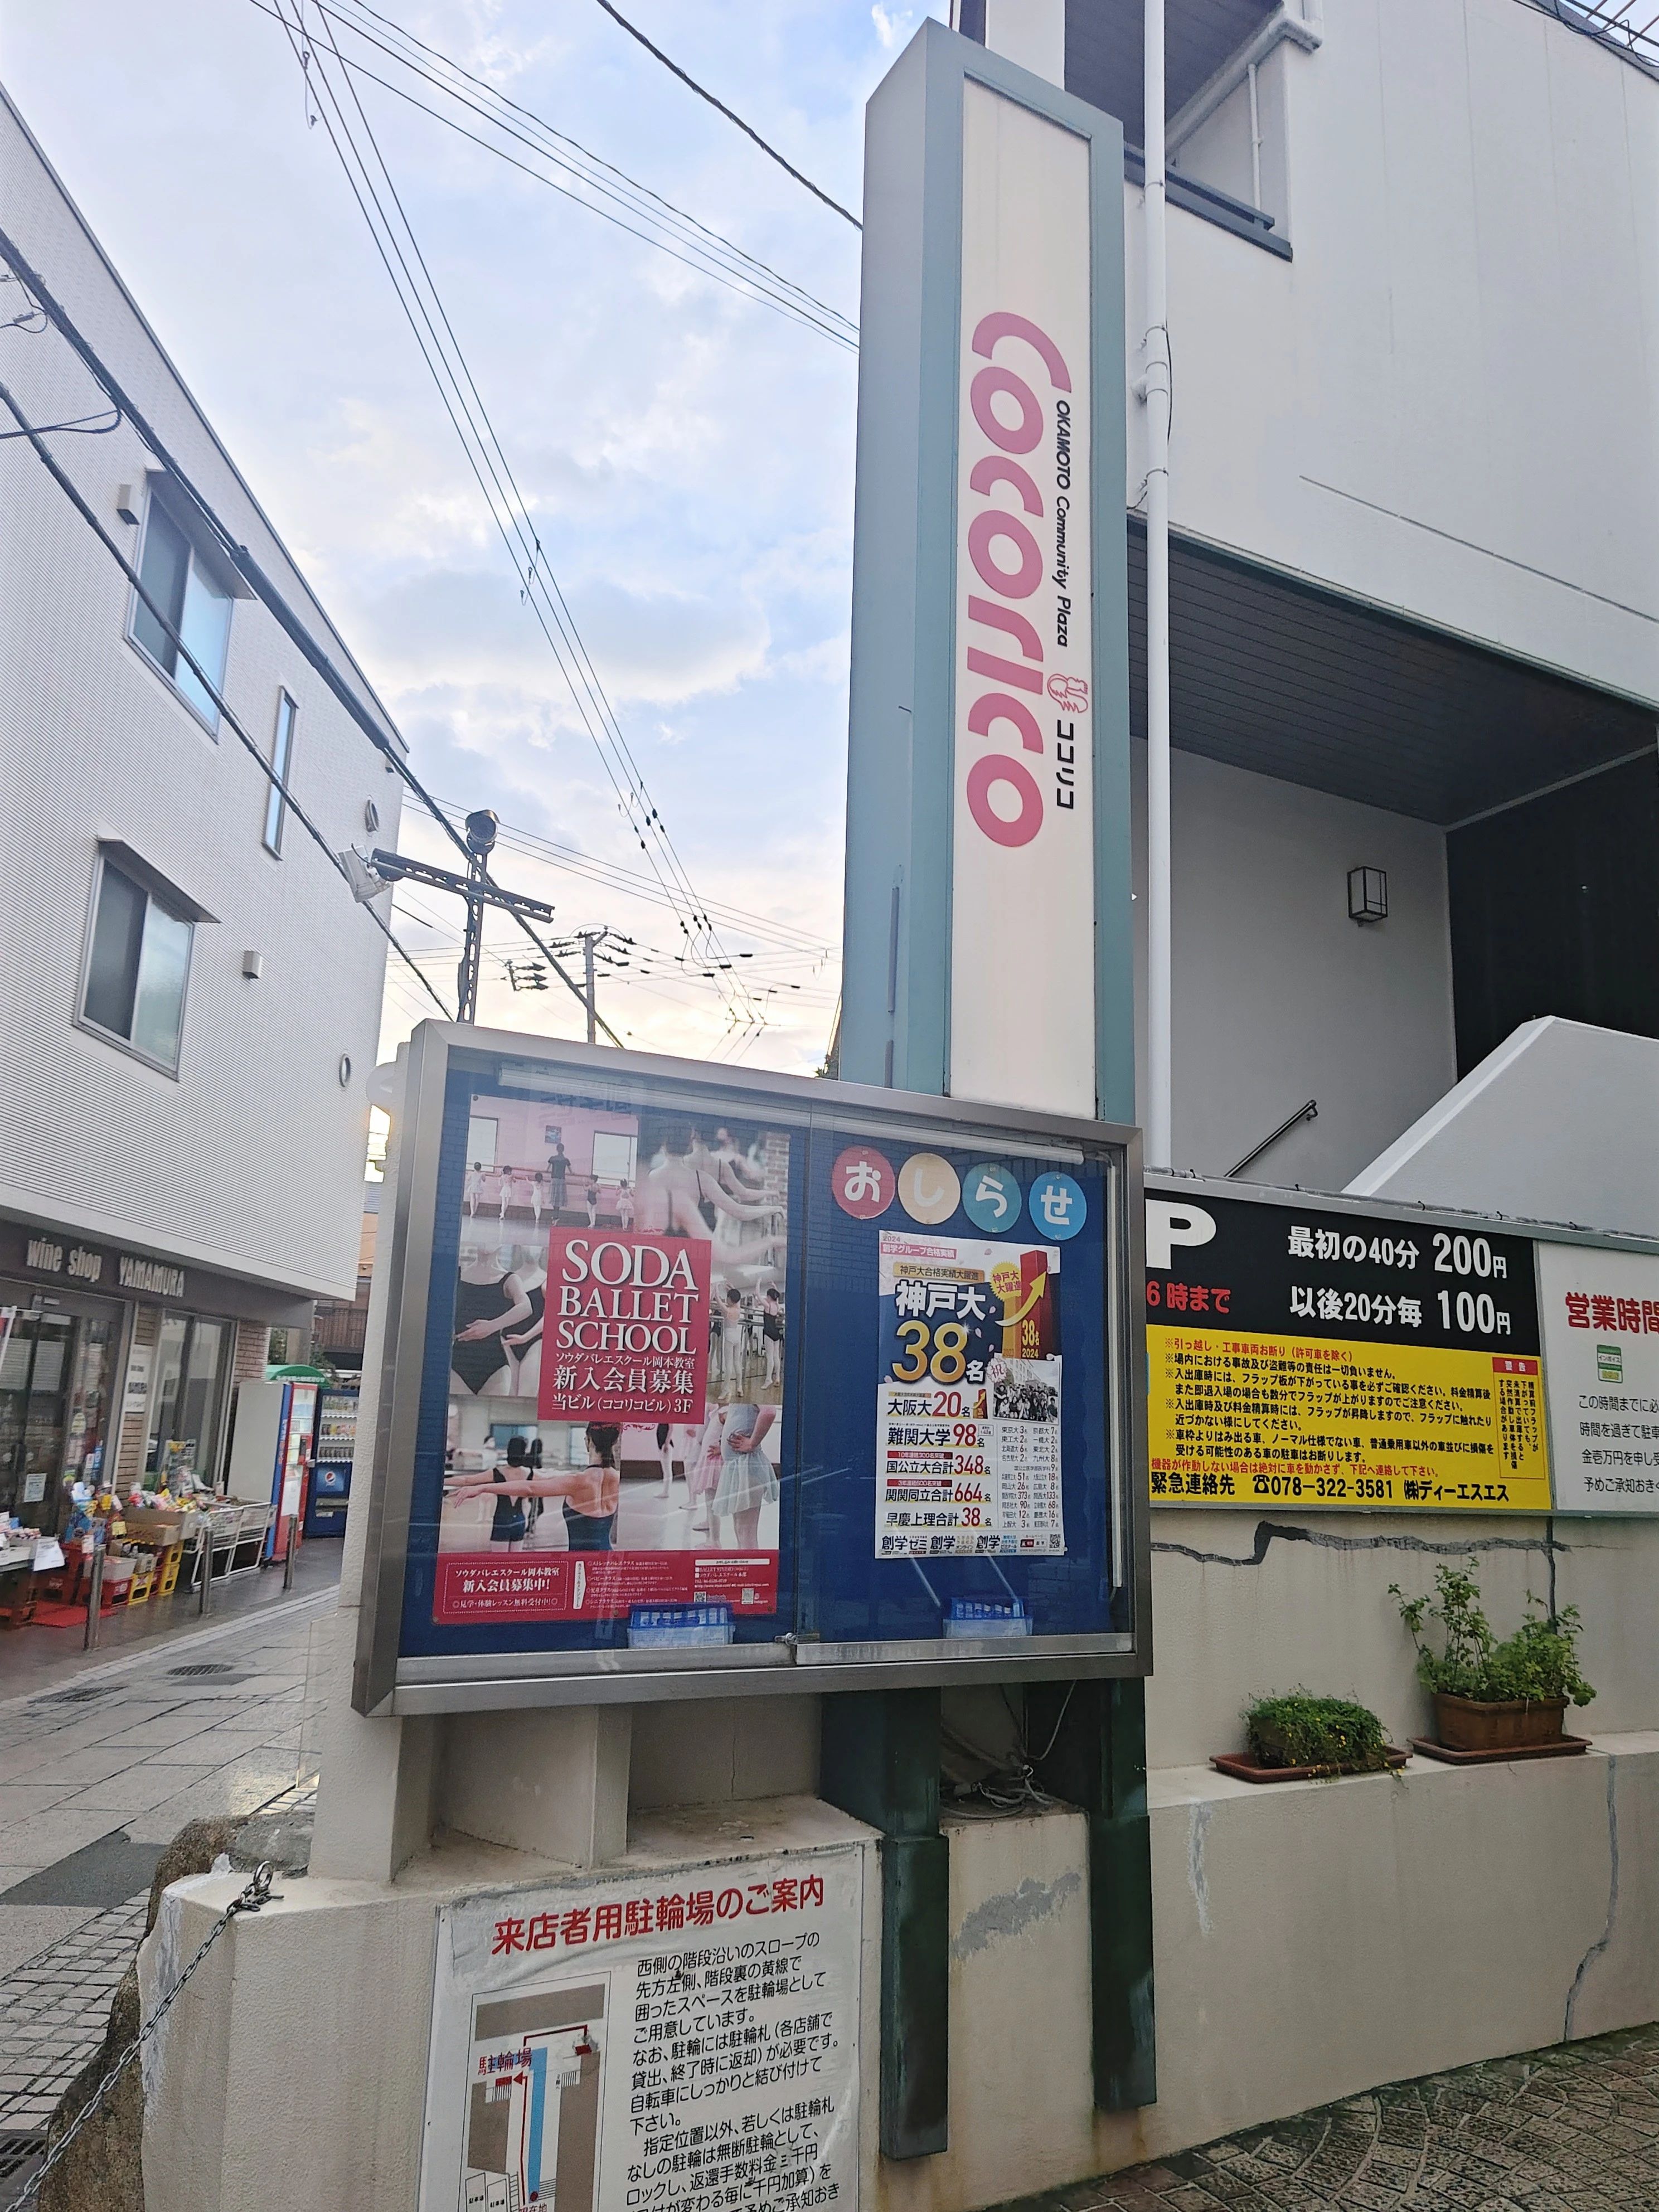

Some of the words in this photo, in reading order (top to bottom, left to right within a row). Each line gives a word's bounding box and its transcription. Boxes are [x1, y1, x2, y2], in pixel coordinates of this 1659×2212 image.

[1055, 398, 1071, 490] OKAMOTO
[1055, 496, 1071, 590] Community
[966, 311, 1073, 848] Cocorico
[1055, 594, 1071, 648] Plaza
[1056, 719, 1074, 810] ココリコ
[844, 1160, 1074, 1225] おしらせ
[1145, 1198, 1216, 1270] P
[1287, 1225, 1420, 1269] 最初の40分
[1432, 1233, 1507, 1279] 200円
[27, 1237, 62, 1272] wine
[68, 1246, 101, 1282] shop
[119, 1257, 185, 1297] YAMAMURA
[562, 1239, 699, 1291] SODA
[992, 1270, 1019, 1283] 神戸大
[557, 1286, 699, 1323] BALLET
[895, 1280, 986, 1321] 神戸大
[1289, 1286, 1423, 1328] 以後20分毎
[1437, 1290, 1511, 1335] 100円
[556, 1320, 697, 1355] SCHOOL
[892, 1320, 984, 1384] 38名
[1022, 1320, 1040, 1346] 38名
[1022, 1348, 1039, 1359] 2024
[552, 1364, 695, 1395] 新入会員募集
[555, 1352, 696, 1370] ソウダバレエスクール岡本教室
[992, 1365, 1005, 1379] 祝
[887, 1390, 971, 1418] 大阪大20名
[1175, 1413, 1303, 1432] 近づかない様にしてください。
[886, 1454, 991, 1475] 国公立大合計348名
[1151, 1471, 1235, 1495] 緊急連絡先
[886, 1507, 992, 1527] 早慶上理合計38名
[881, 1535, 927, 1551] 創学ゼミ
[930, 1535, 955, 1551] 創学
[976, 1535, 1000, 1550] 創学
[491, 1874, 825, 1955] 来店者用駐輪場のご案内
[637, 1932, 820, 1977] 西側の階段沿いのスロープの
[635, 1972, 827, 2022] 囲ったスペースを駐輪場として
[633, 2007, 755, 2044] ご用意しています。
[478, 2047, 533, 2075] 駐輪場
[630, 2056, 822, 2114] 自転車にしっかりと結び付けて
[630, 2112, 682, 2136] 下さい。
[643, 2095, 835, 2157] 指定位置以外、若しくは駐輪札
[627, 2122, 819, 2182] なしの駐輪は無断駐輪として、
